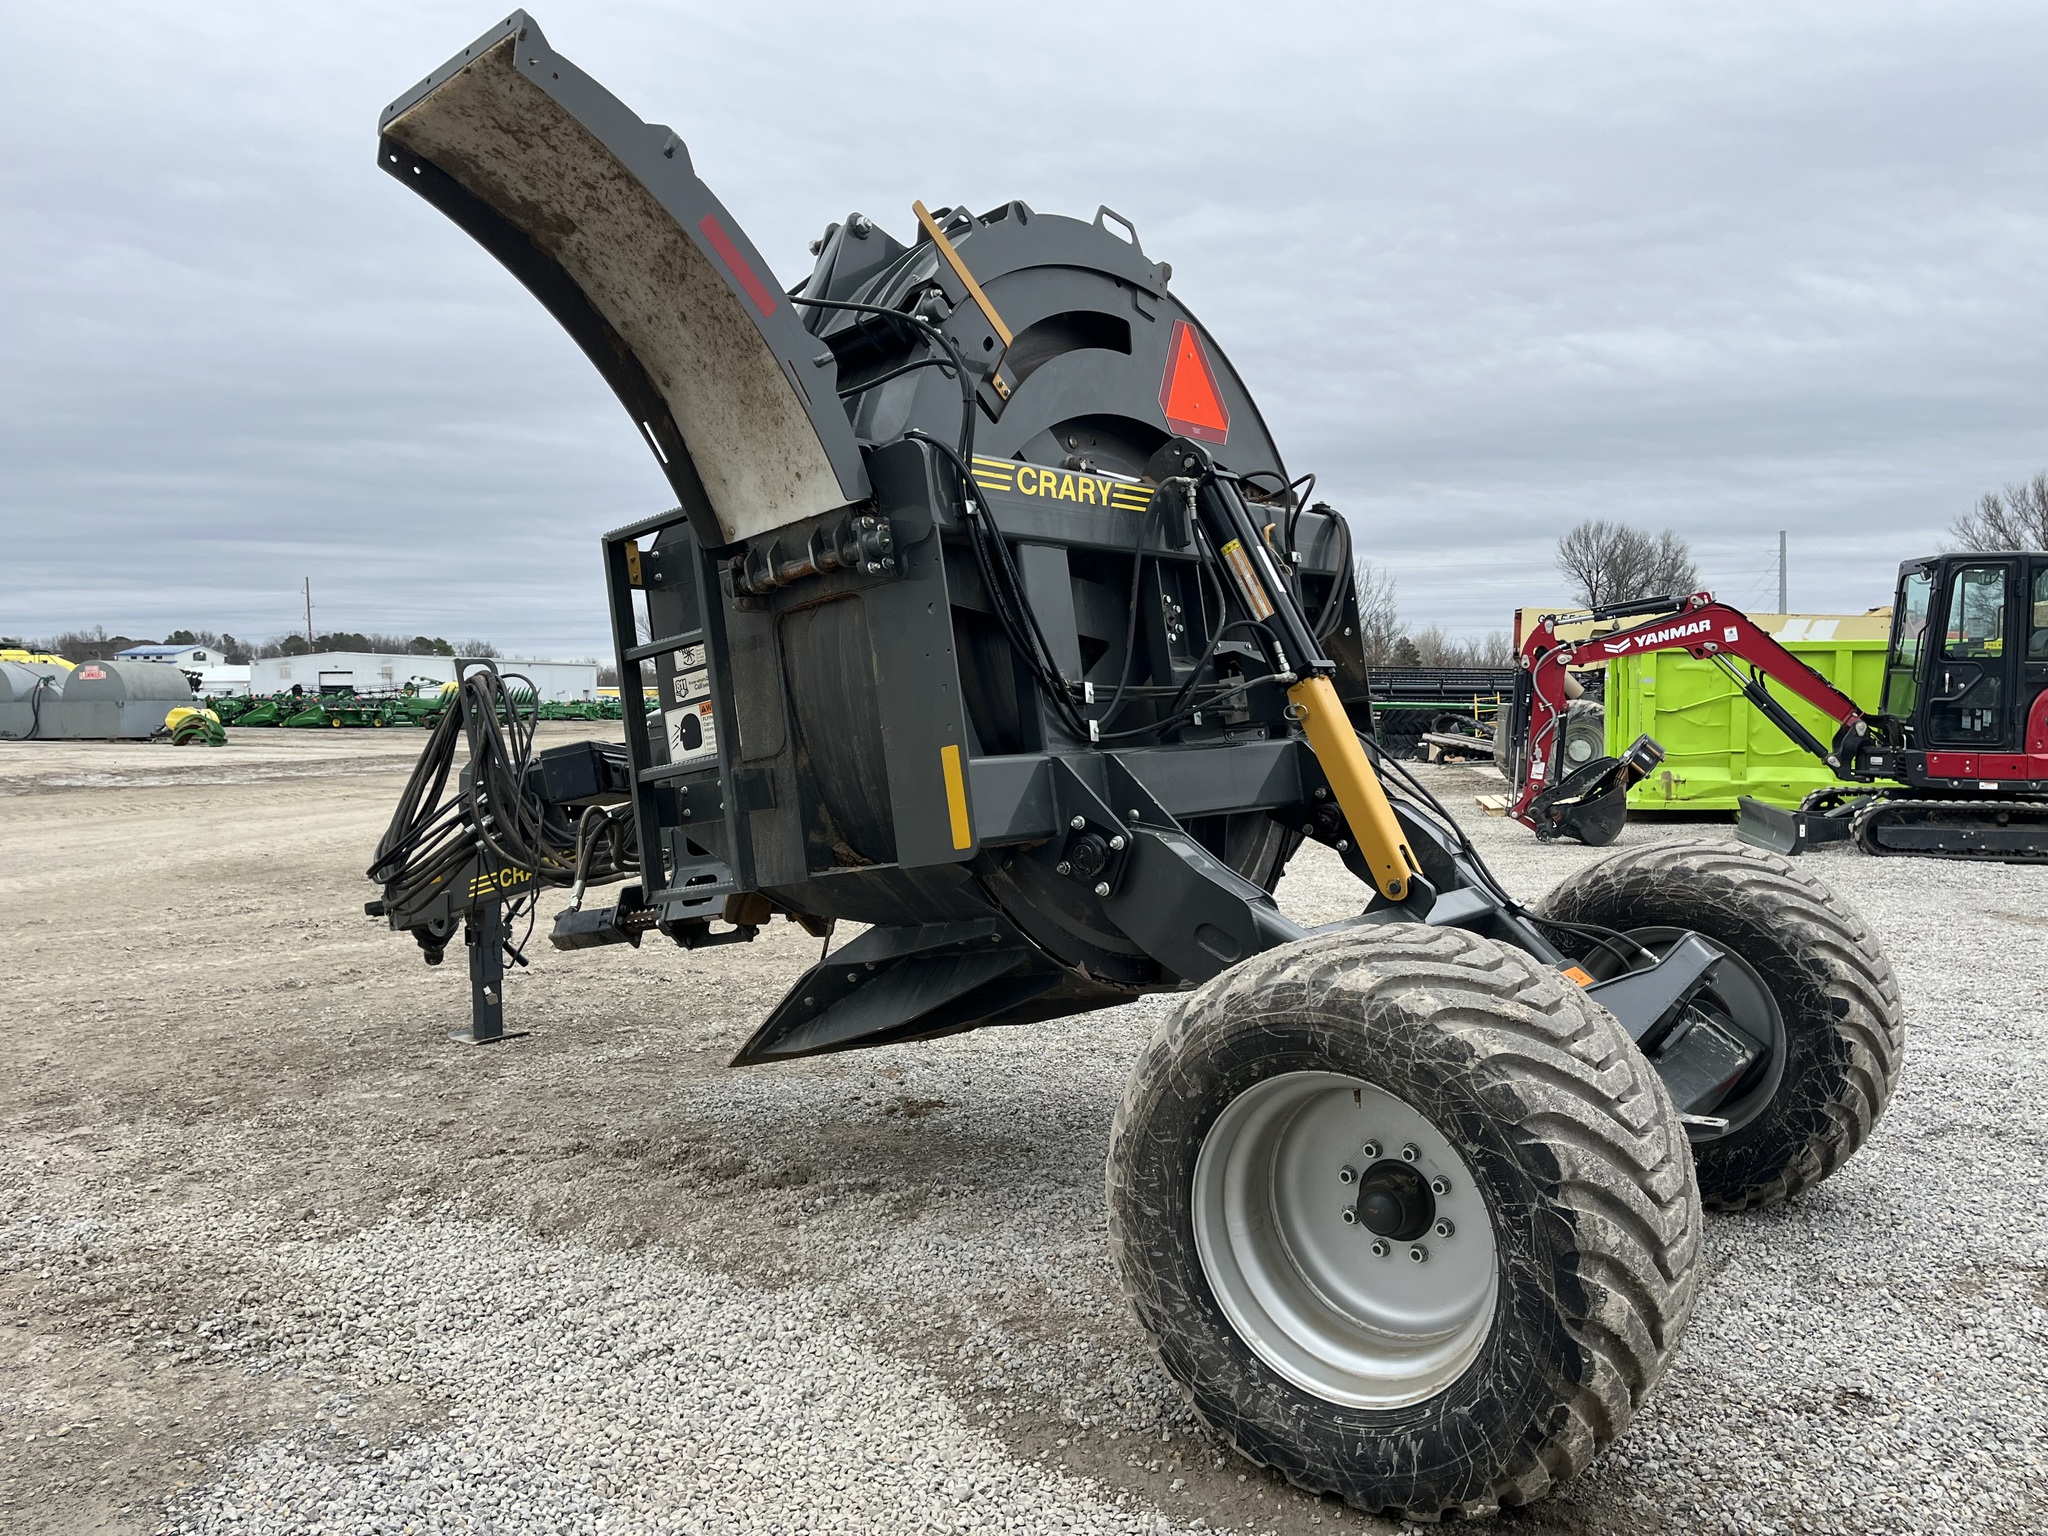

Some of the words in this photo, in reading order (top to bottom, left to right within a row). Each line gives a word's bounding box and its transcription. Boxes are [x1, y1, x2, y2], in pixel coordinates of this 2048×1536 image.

[1016, 466, 1113, 507] CRARY
[1633, 619, 1711, 648] YANMAR
[675, 678, 687, 692] 811
